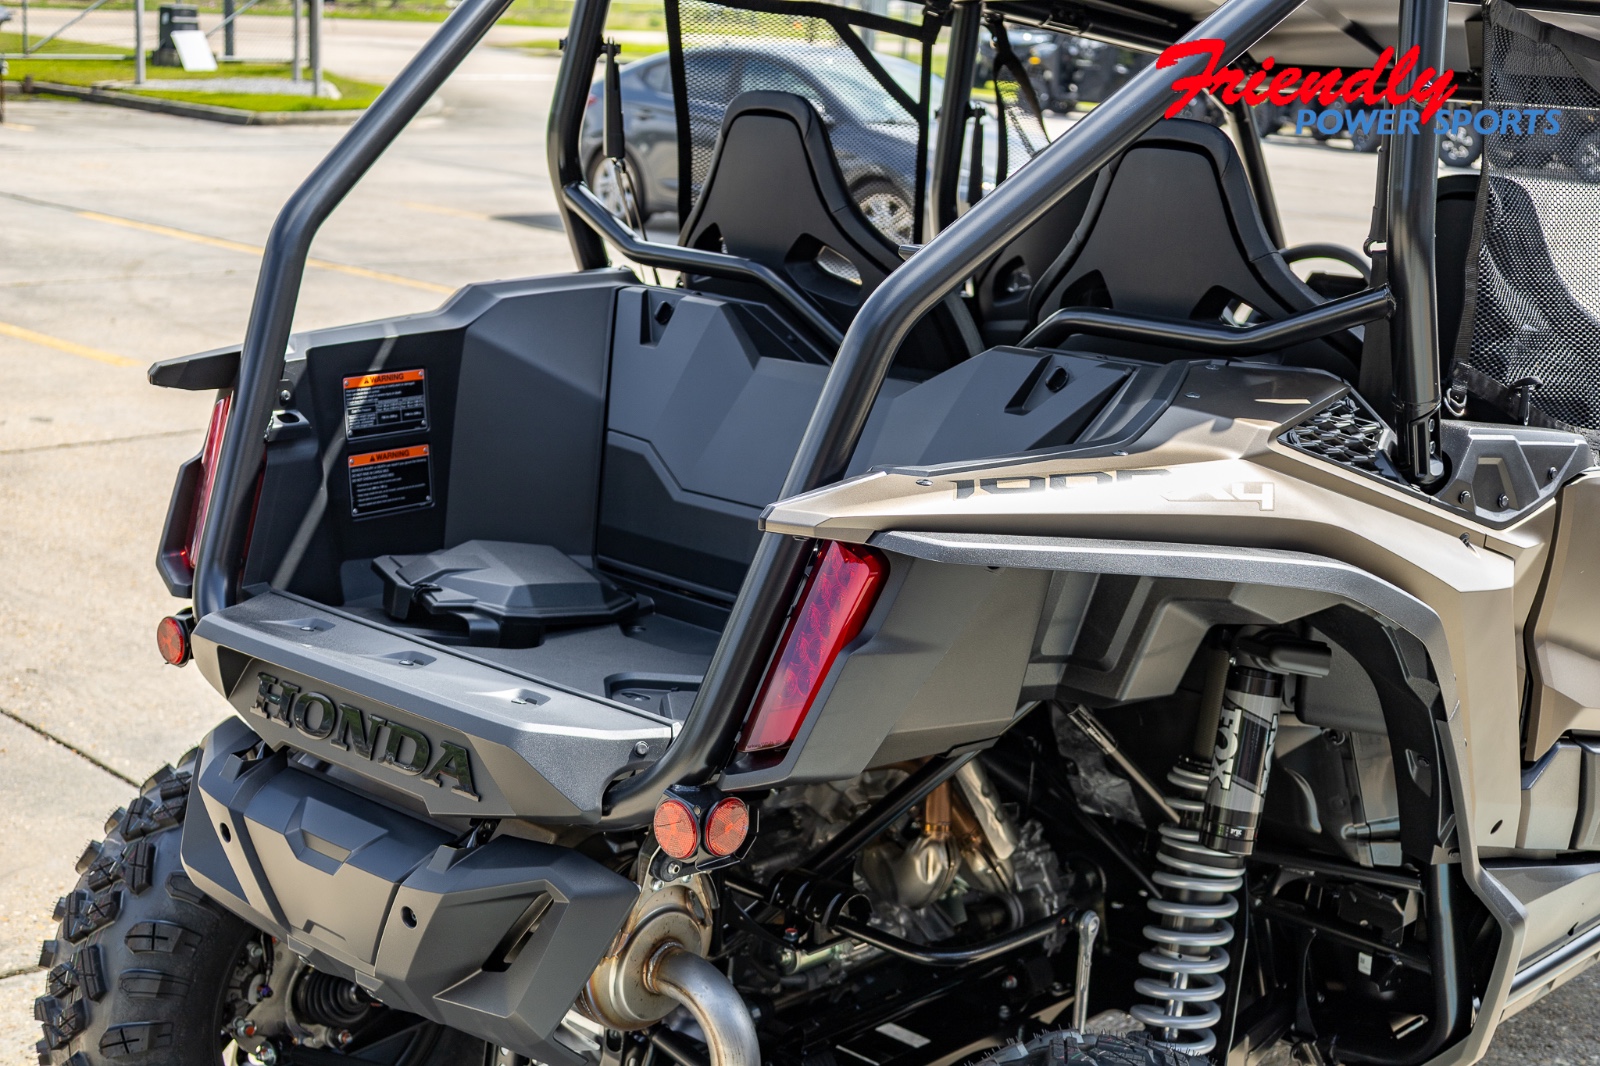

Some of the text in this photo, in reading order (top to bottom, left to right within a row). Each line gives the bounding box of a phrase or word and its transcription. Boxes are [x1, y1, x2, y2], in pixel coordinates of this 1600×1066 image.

[371, 372, 404, 383] WARNING
[376, 449, 410, 461] WARNING
[250, 671, 481, 802] HONDA
